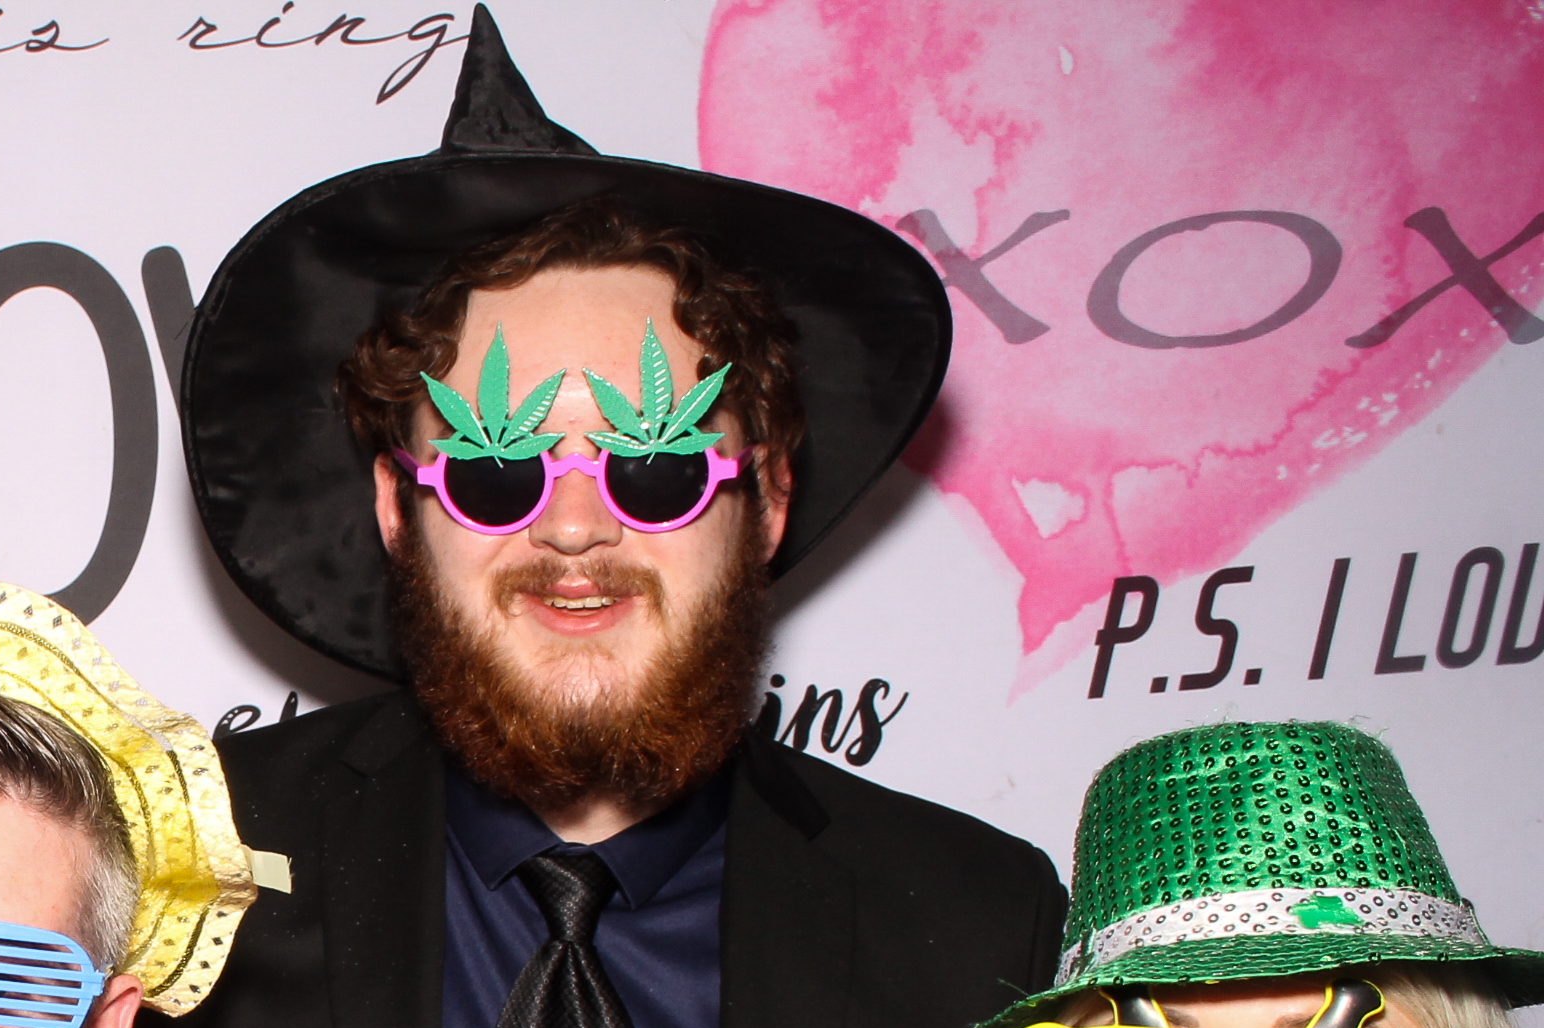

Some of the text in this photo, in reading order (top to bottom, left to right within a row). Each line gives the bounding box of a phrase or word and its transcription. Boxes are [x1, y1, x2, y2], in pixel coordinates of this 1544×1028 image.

[177, 1, 471, 105] ring
[1087, 565, 1263, 700] P.S.
[1307, 557, 1352, 681] I
